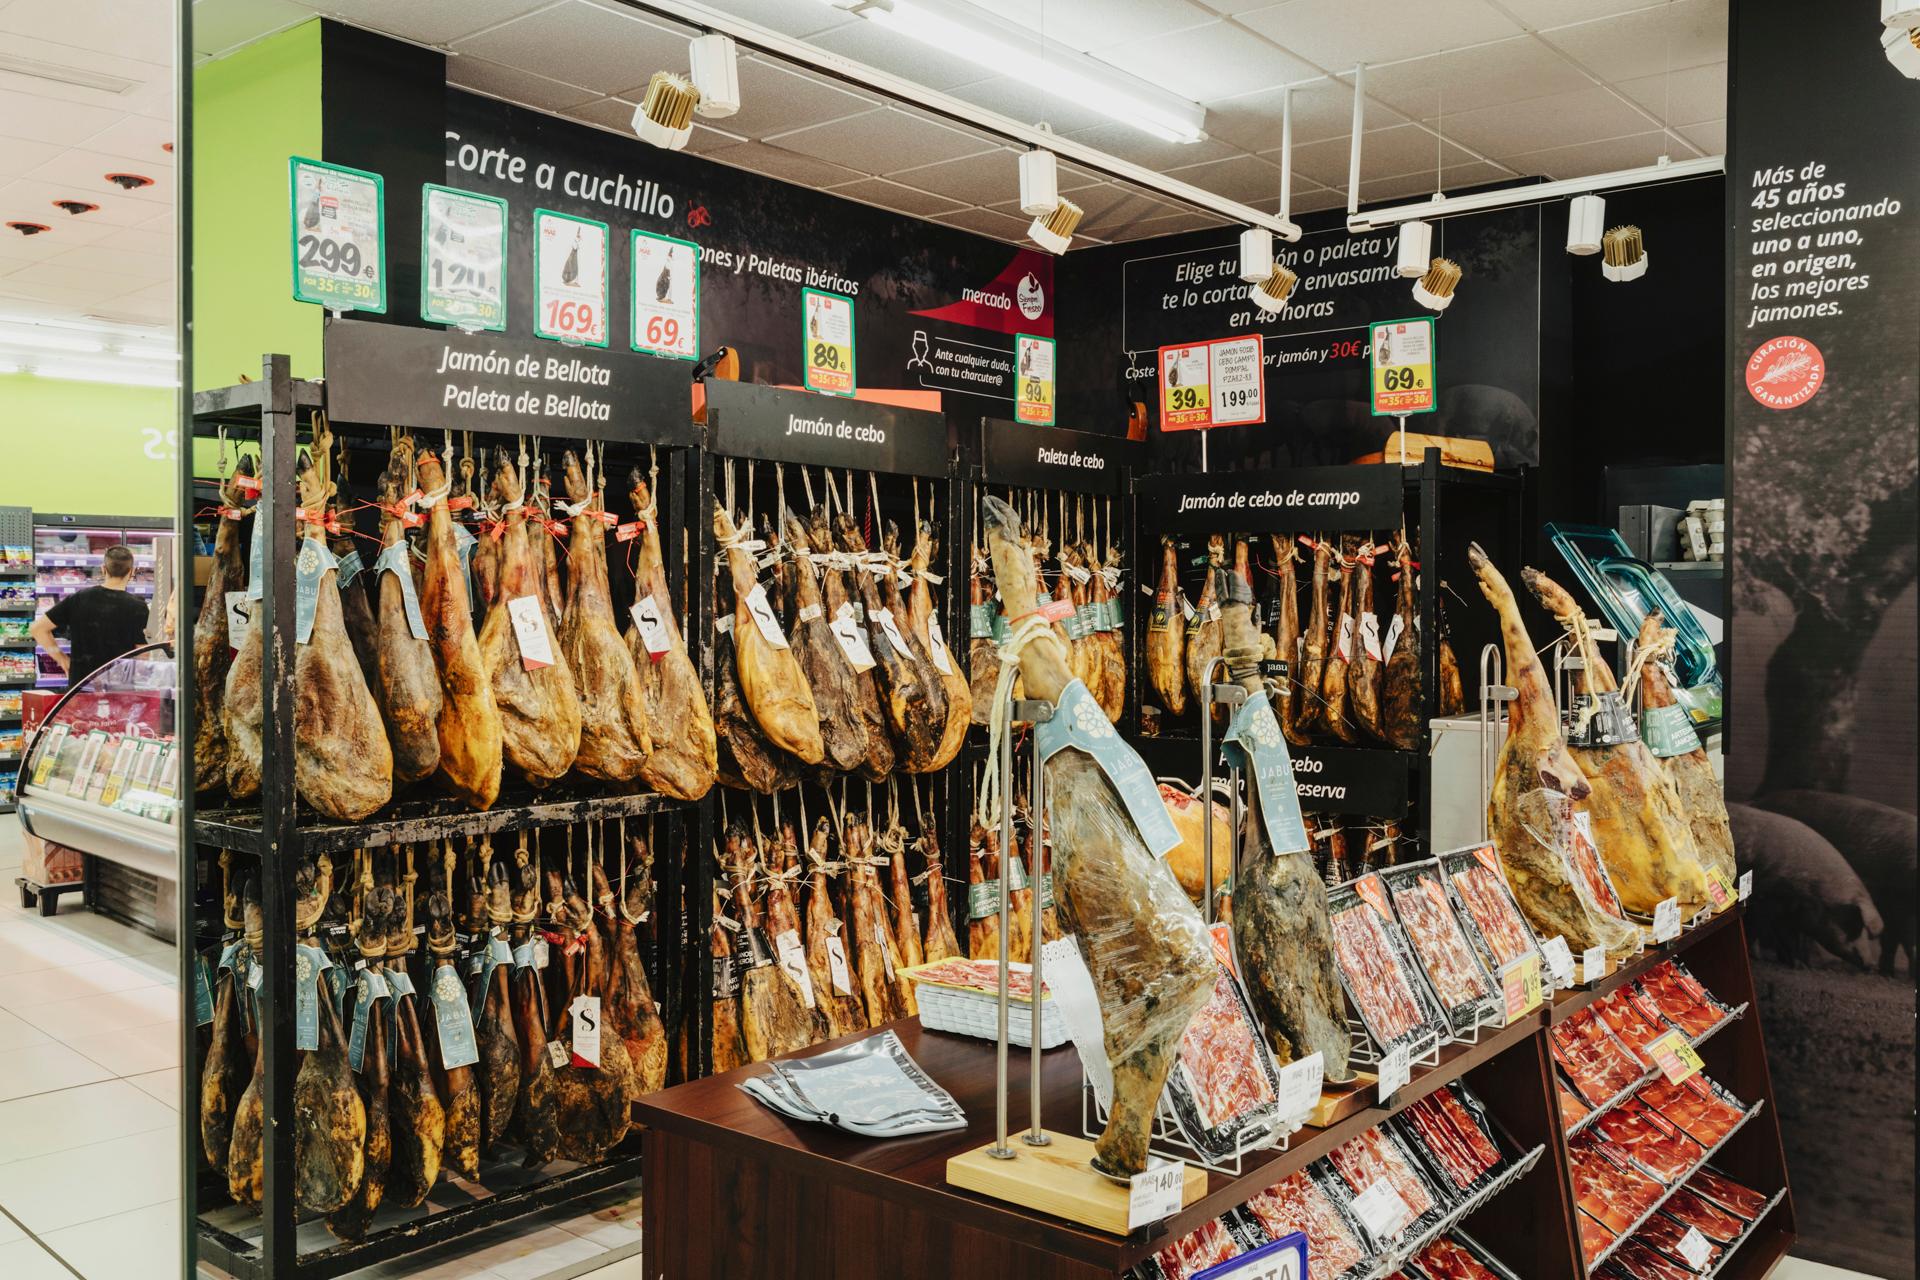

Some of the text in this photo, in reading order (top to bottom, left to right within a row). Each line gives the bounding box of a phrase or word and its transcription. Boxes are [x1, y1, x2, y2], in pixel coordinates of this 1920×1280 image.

[446, 131, 675, 219] Corte a cuchillo
[1752, 161, 1826, 187] Más de
[1751, 182, 1846, 210] 45 años
[1751, 197, 1901, 233] seleccionando
[1752, 229, 1864, 256] uno a uno,
[1175, 262, 1214, 285] Elige
[1218, 259, 1237, 276] tu
[1303, 248, 1315, 264] o
[1318, 238, 1381, 267] paleta
[1385, 235, 1398, 257] y
[1751, 253, 1857, 278] en origen,
[734, 254, 745, 274] y
[748, 254, 802, 283] Paletas
[805, 267, 859, 295] ibéricos
[1751, 274, 1870, 301] los mejores
[962, 287, 1011, 311] mercado
[1162, 292, 1178, 310] te
[1182, 288, 1198, 307] lo
[1229, 311, 1251, 327] en
[1281, 301, 1334, 321] horas
[1747, 301, 1843, 329] jamones.
[436, 346, 611, 386] Jamón de Bellota
[935, 348, 1011, 372] Ante cualquier duda,
[1125, 365, 1155, 380] Coste
[1276, 348, 1317, 367] jamón
[1319, 349, 1329, 363] y
[1330, 340, 1361, 358] 30€
[1751, 338, 1808, 371] CURACIÓN
[935, 365, 1003, 386] con tu charcuter@
[1754, 364, 1821, 405] GARANTIZADA
[443, 384, 611, 421] Paleta de Bellota
[785, 413, 885, 444] Jamón de cebo
[1038, 447, 1105, 470] Paleta de cebo
[1178, 490, 1360, 513] Jamón de cebo de campo
[1260, 765, 1290, 779] JABU
[1290, 756, 1323, 773] cebo
